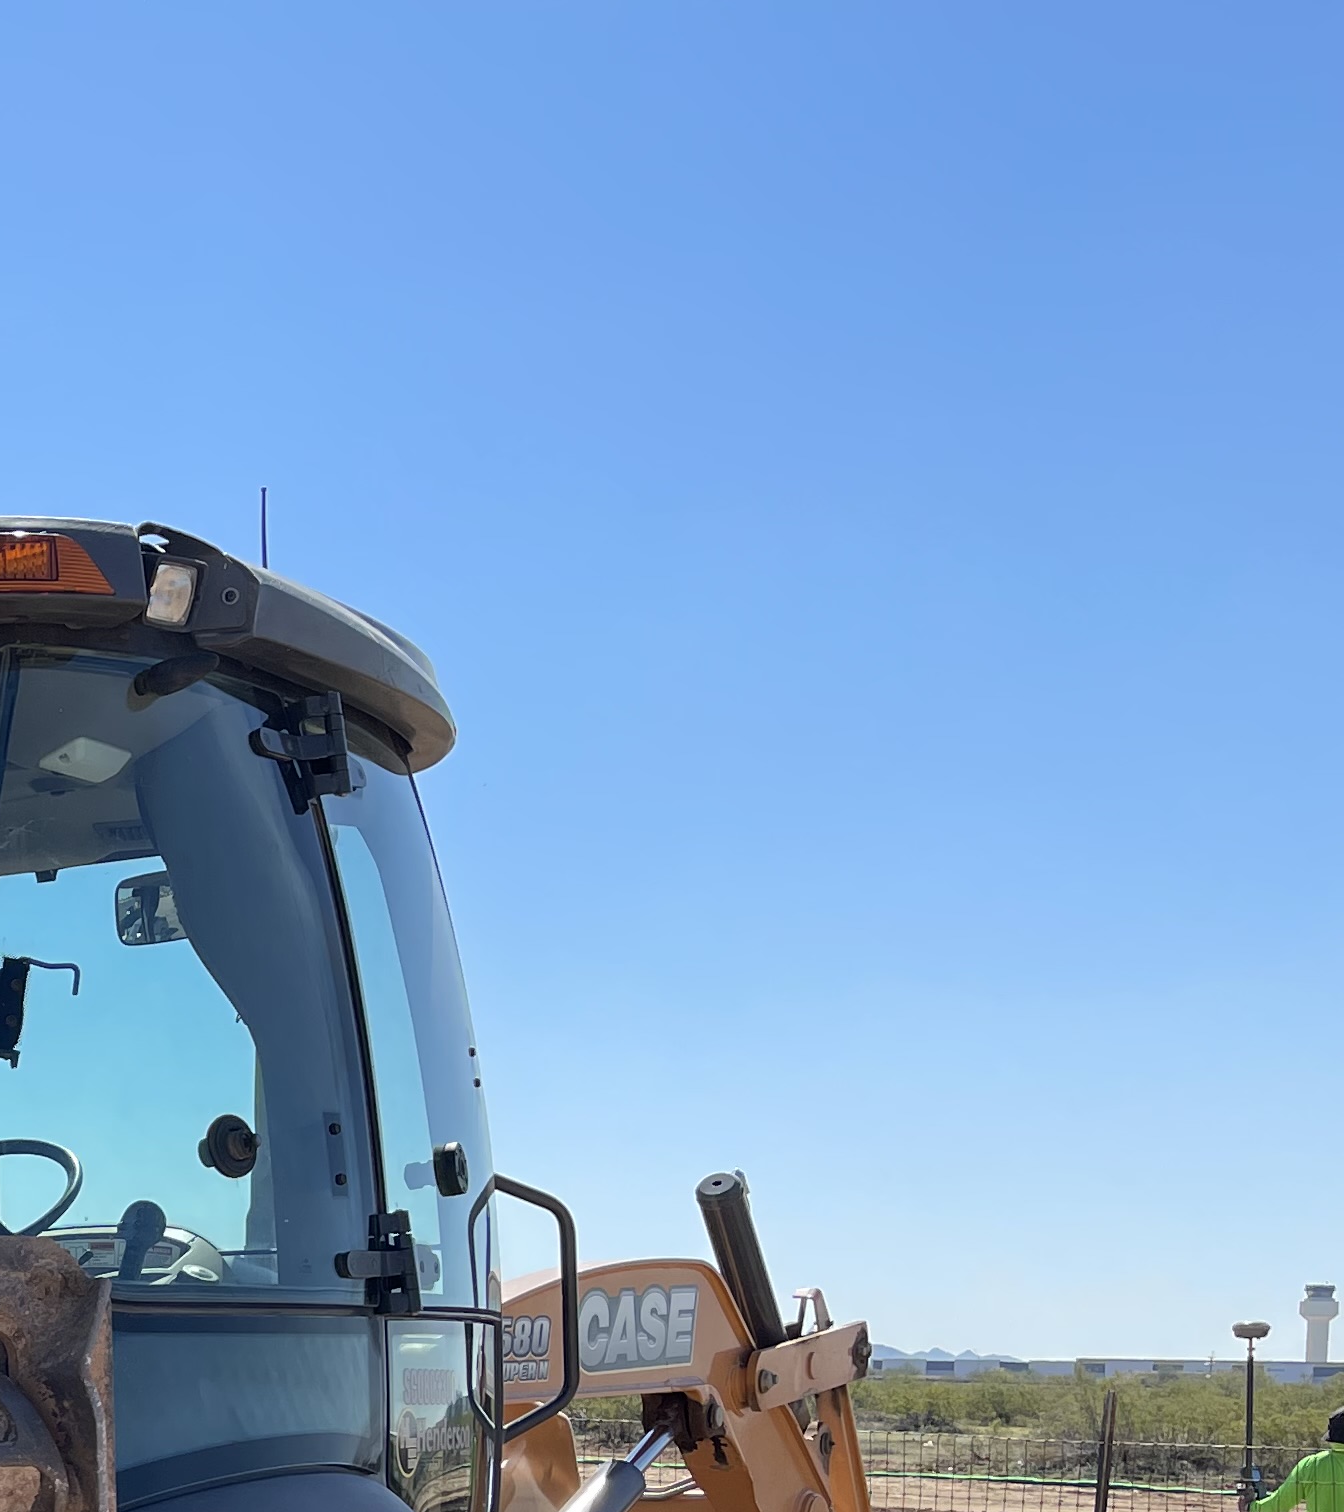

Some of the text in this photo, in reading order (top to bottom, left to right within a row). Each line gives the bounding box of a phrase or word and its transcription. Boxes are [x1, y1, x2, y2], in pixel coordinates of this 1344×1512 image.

[502, 1315, 551, 1357] 580
[580, 1285, 698, 1369] CASE
[502, 1360, 537, 1381] UPER
[416, 1417, 471, 1452] Henderson
